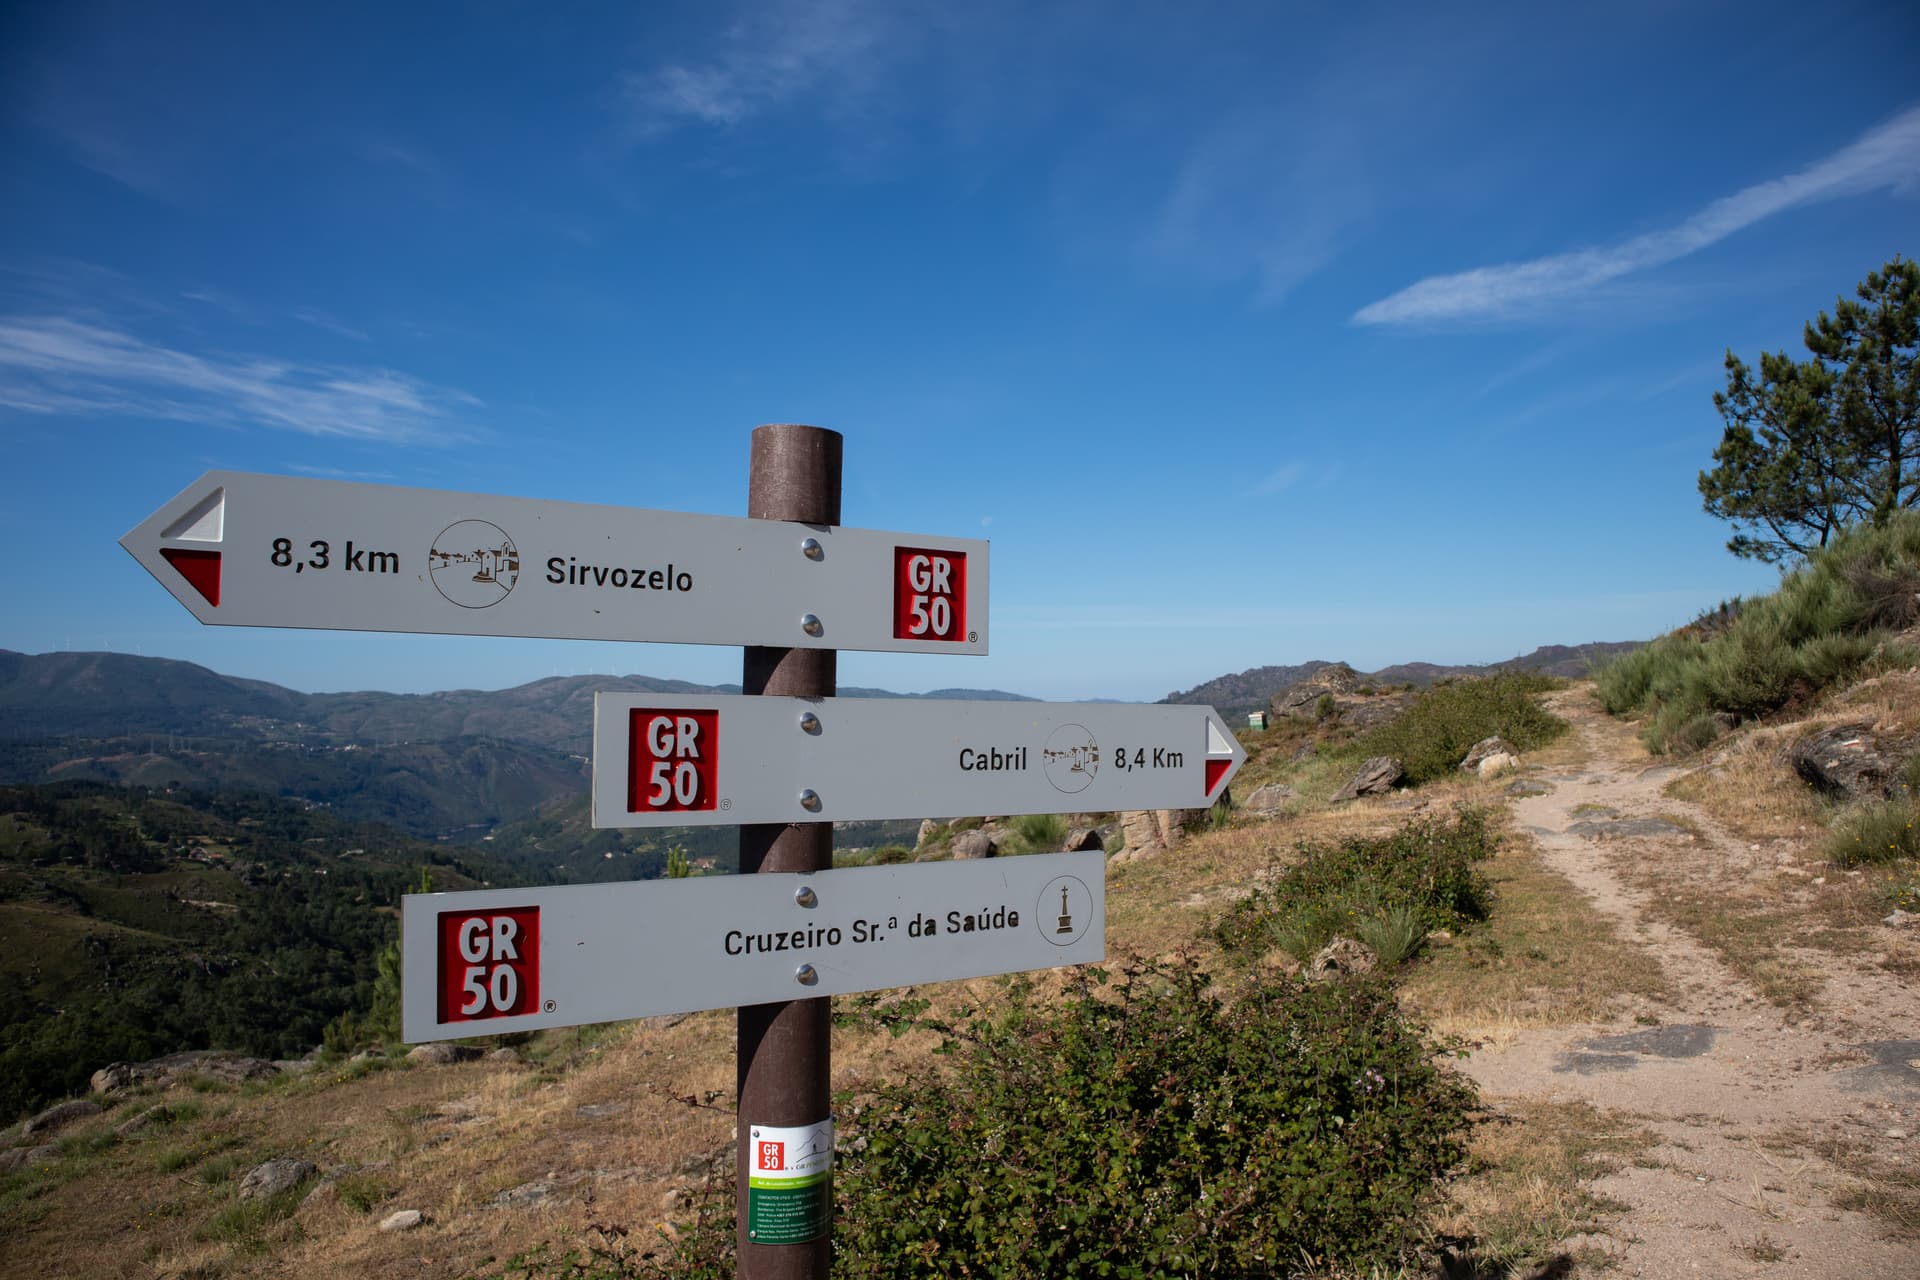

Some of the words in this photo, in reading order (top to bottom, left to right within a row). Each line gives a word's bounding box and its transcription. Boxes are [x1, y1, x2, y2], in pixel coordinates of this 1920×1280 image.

[270, 537, 330, 573] 8,3
[345, 541, 399, 574] km
[545, 556, 693, 592] Sirvozelo
[909, 555, 951, 595] GR
[909, 595, 951, 636] 50
[647, 715, 699, 759] GR
[959, 747, 1027, 771] Cabril
[1114, 748, 1145, 772] 8,4
[1153, 748, 1184, 768] Km
[647, 761, 698, 807] 50
[459, 916, 518, 963] GR
[724, 922, 842, 956] Cruzeiro
[908, 913, 937, 938] da
[946, 905, 1020, 934] Saúde
[461, 963, 518, 1015] 50
[763, 1143, 779, 1156] GR
[764, 1156, 779, 1169] 50
